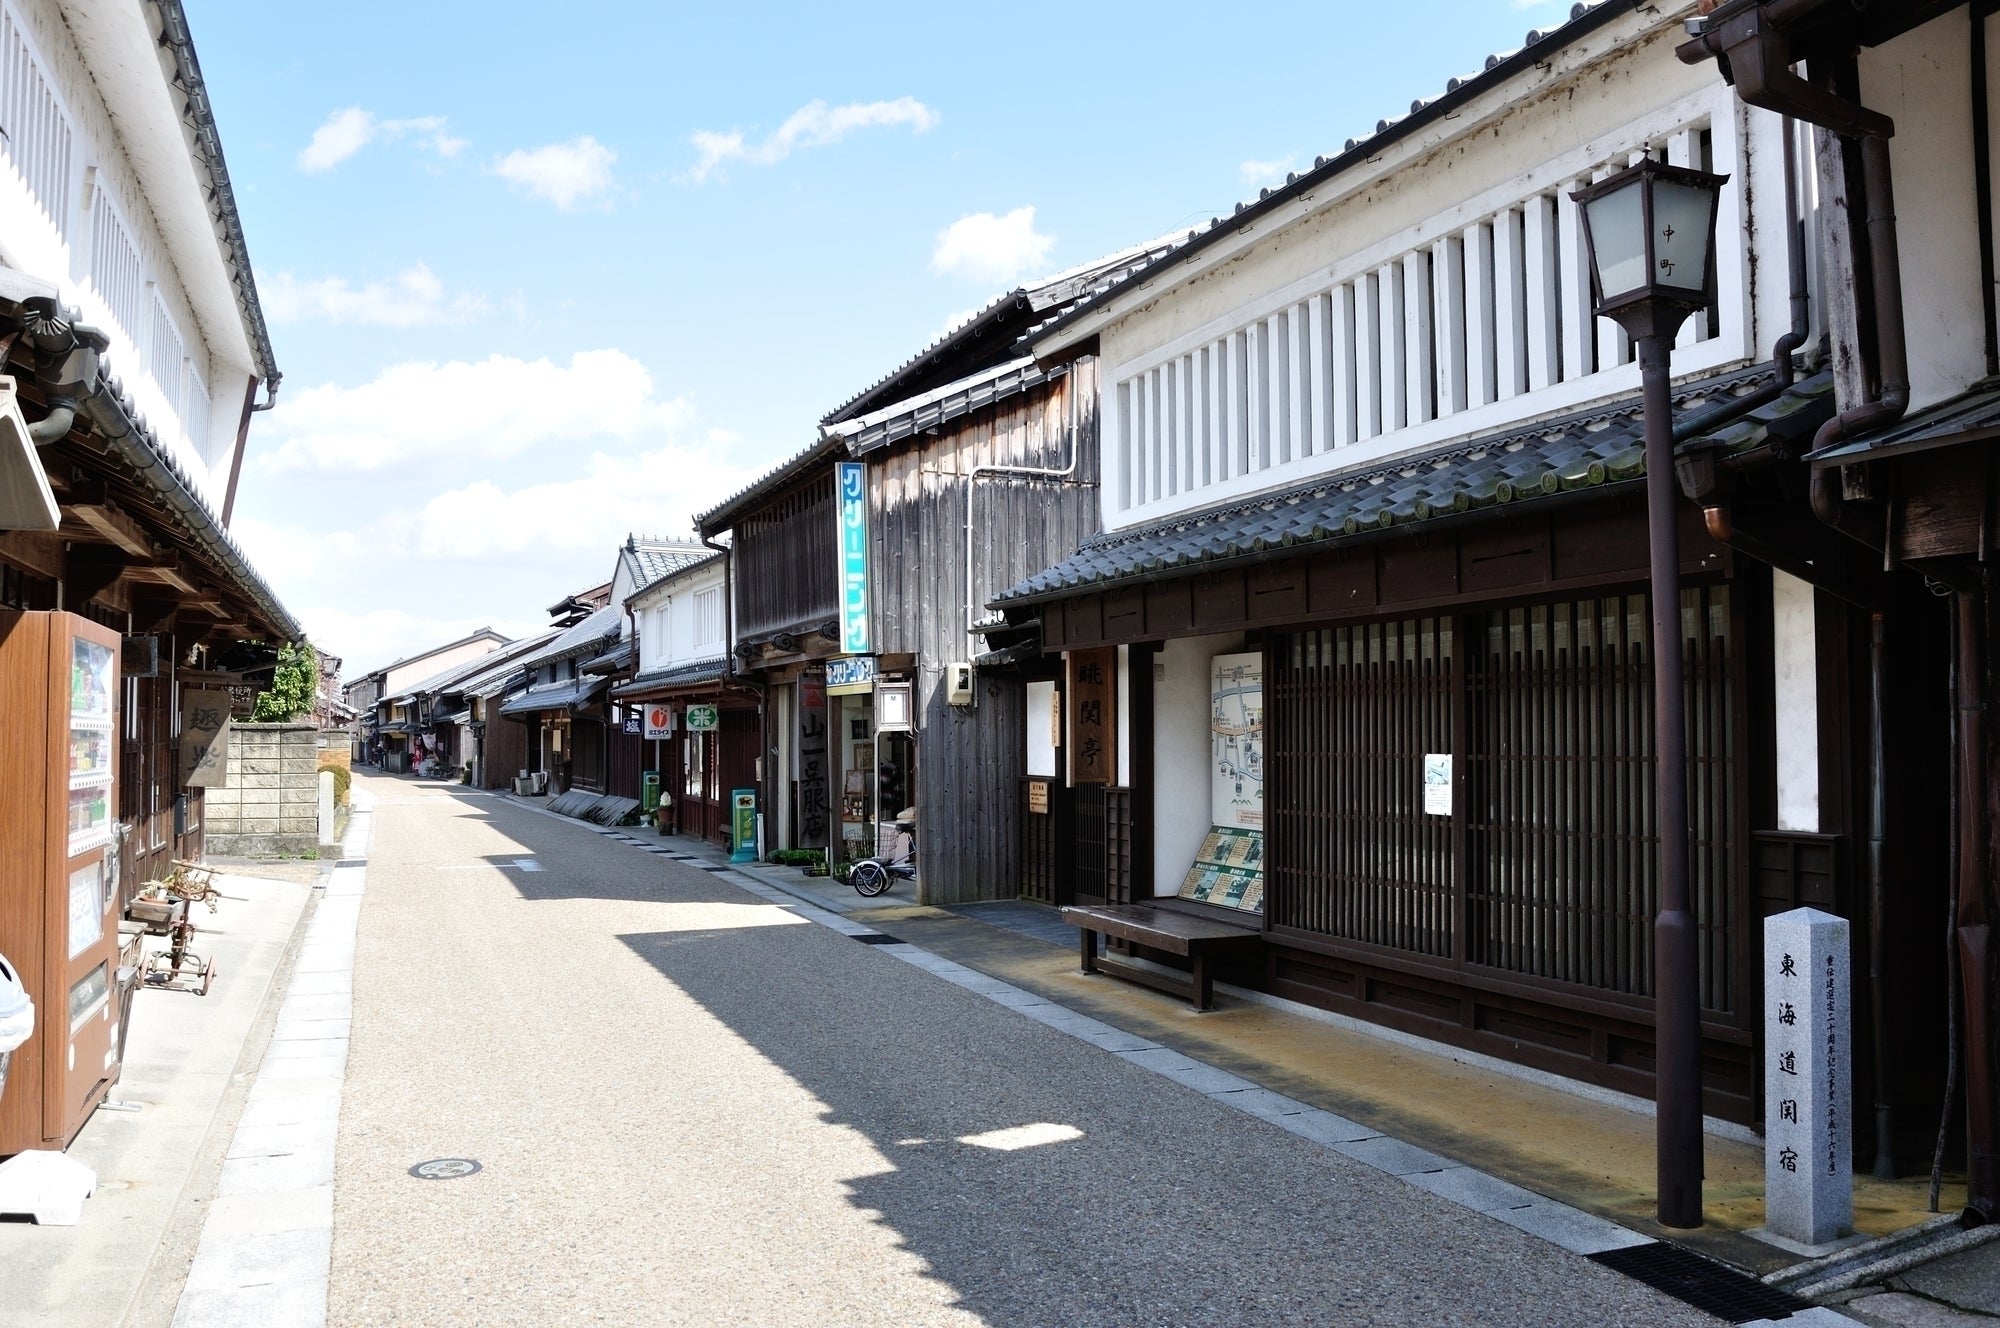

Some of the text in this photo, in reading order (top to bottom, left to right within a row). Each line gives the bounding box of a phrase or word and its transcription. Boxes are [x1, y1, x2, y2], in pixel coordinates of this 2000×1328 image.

[1660, 224, 1675, 276] 中町
[843, 468, 866, 647] クリーニング
[833, 657, 873, 683] クリーニング
[1079, 662, 1103, 766] 眺関亭
[626, 720, 641, 733] 塩
[801, 713, 827, 839] 山一呉服店
[1779, 953, 1798, 1172] 東海道関宿
